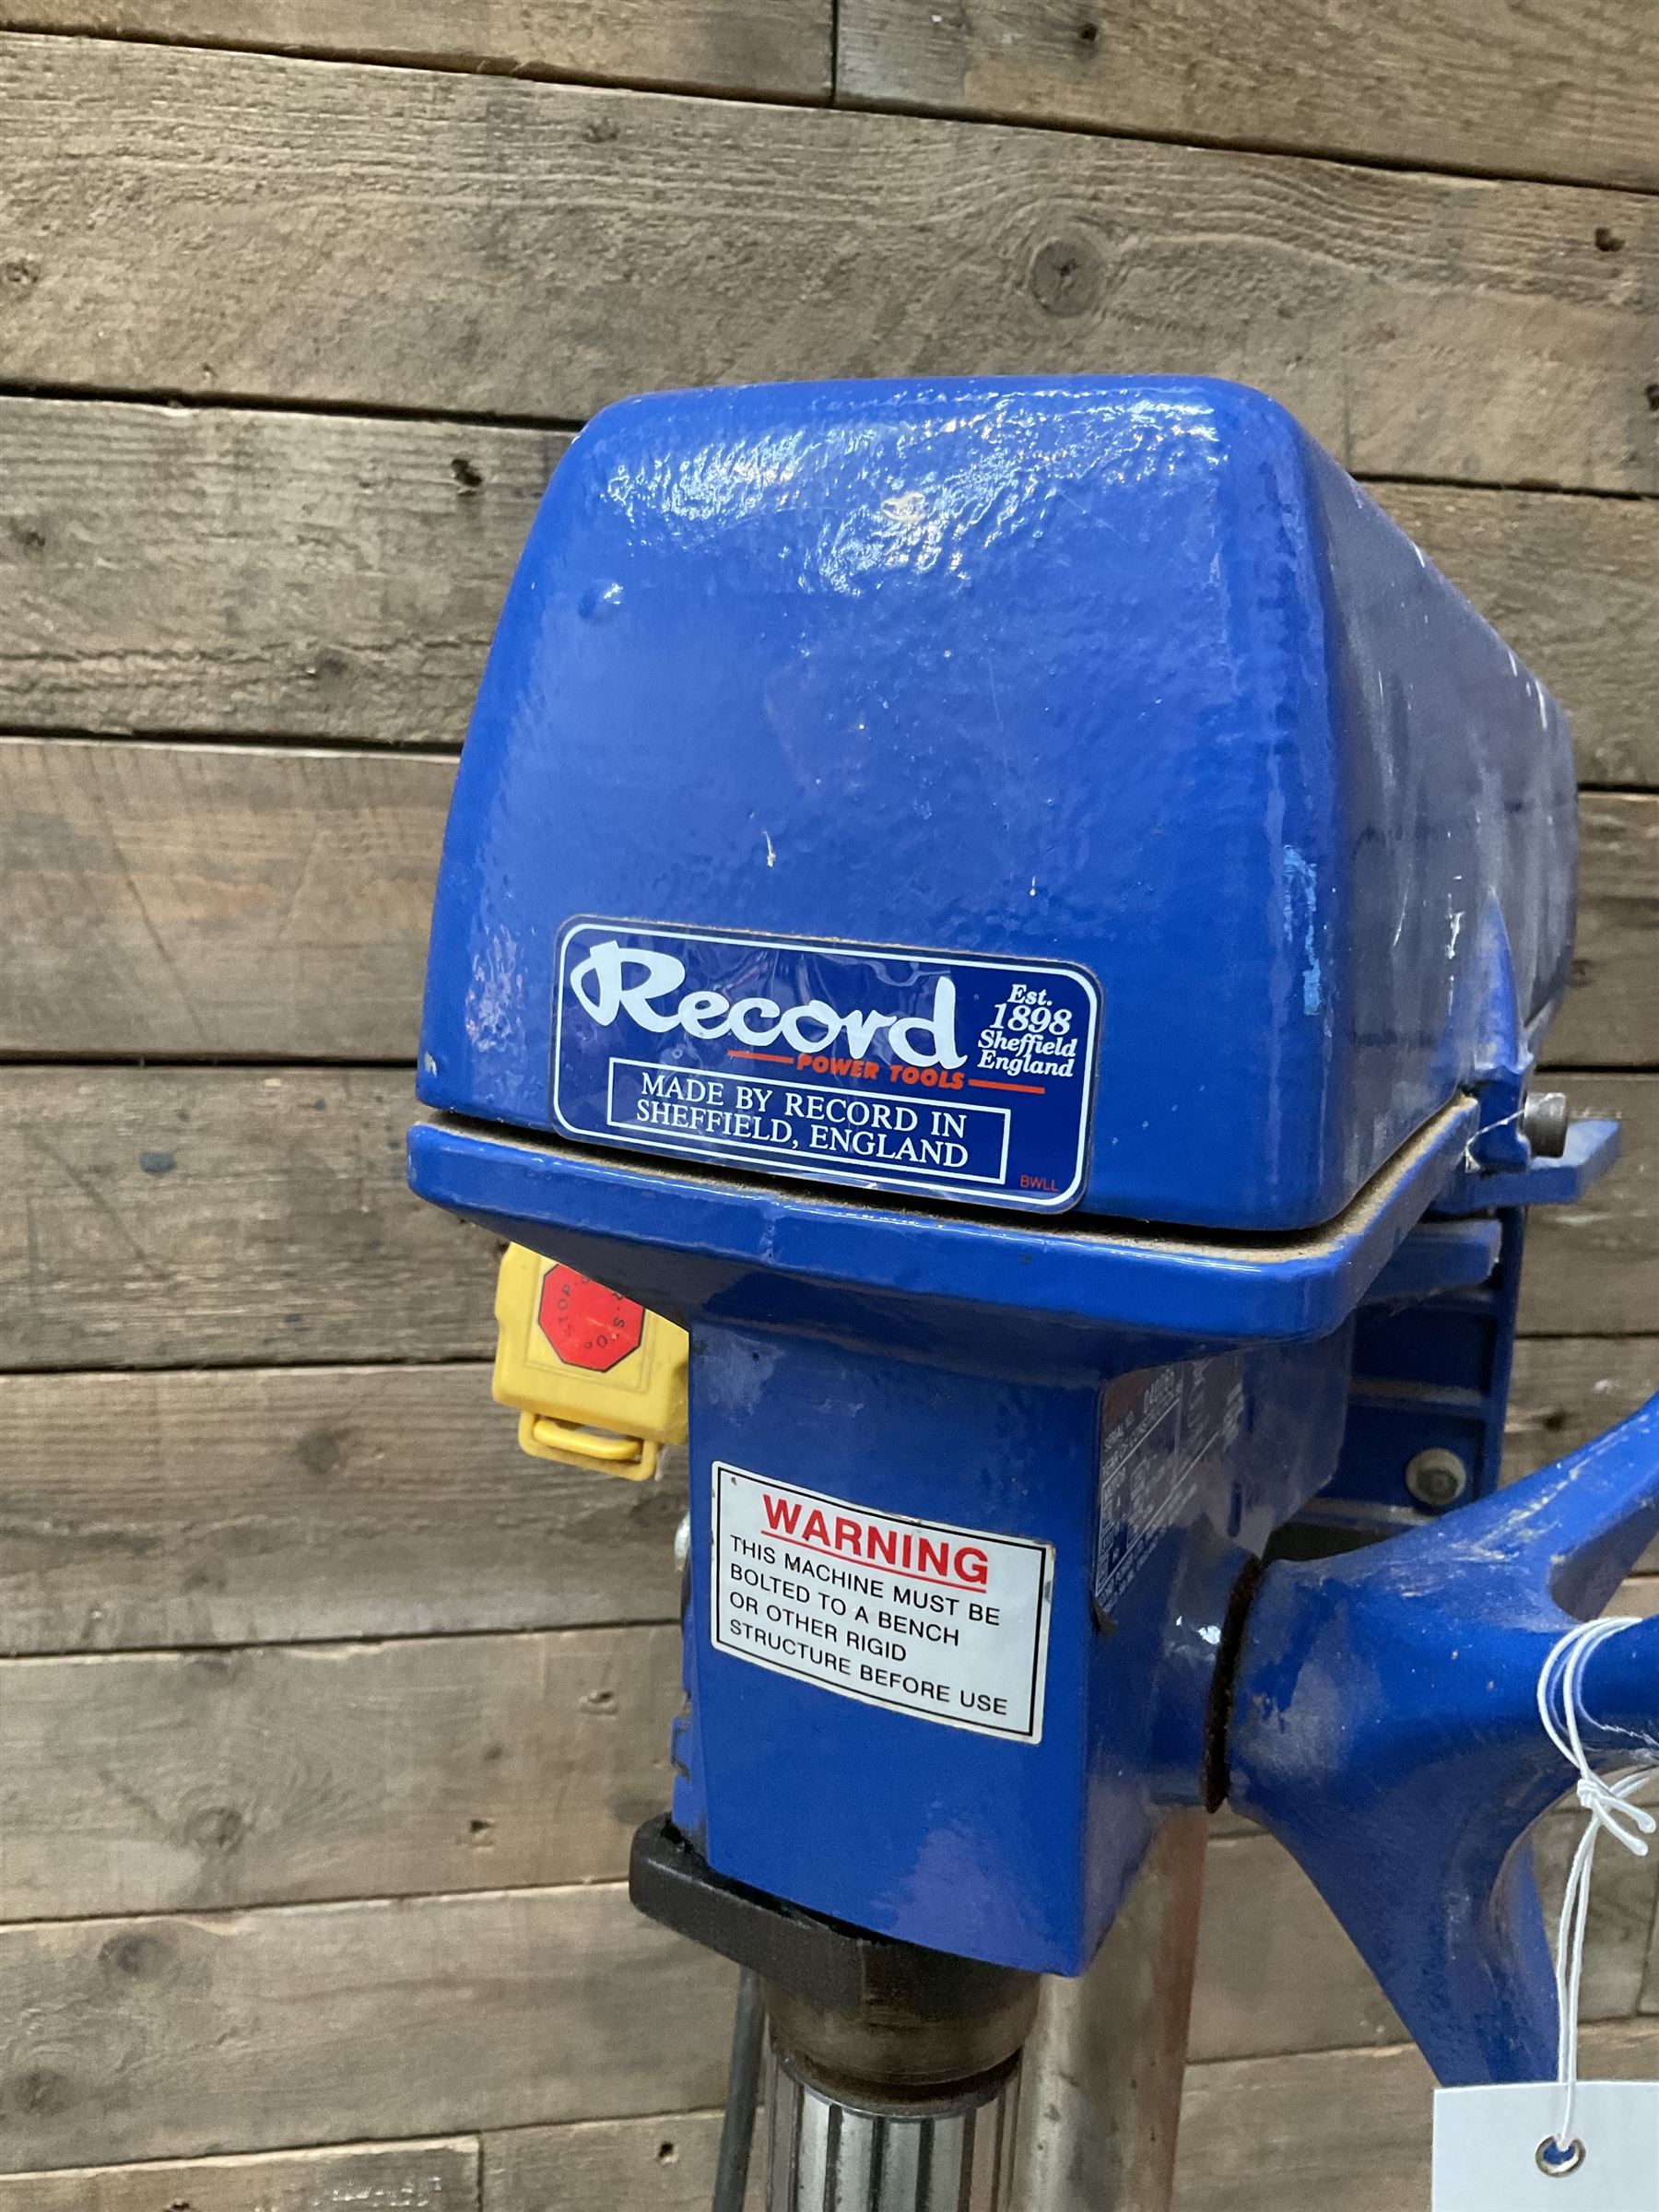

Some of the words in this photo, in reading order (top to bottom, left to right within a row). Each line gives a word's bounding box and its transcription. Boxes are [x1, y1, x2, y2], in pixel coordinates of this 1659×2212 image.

[571, 940, 968, 1069] Record
[992, 1002, 1073, 1036] 1898
[1008, 983, 1053, 1006] Est.
[796, 1053, 879, 1080] POWER
[890, 1063, 964, 1089] TOOLS
[977, 1051, 1074, 1077] England
[978, 1029, 1077, 1058] Sheffield
[636, 1100, 799, 1151] SHEFFIELD,
[809, 1131, 969, 1167] ENGLAND
[641, 1073, 724, 1105] MADE
[735, 1085, 772, 1111] BY
[785, 1093, 918, 1130] RECORD
[931, 1112, 967, 1138] IN
[1020, 1175, 1059, 1193] BWLL
[763, 1493, 988, 1585] WARNING
[731, 1535, 775, 1564] THIS
[784, 1553, 883, 1598] MACHINE
[893, 1585, 959, 1616] MUST
[969, 1604, 1000, 1626] BE
[731, 1564, 810, 1603] BOLTED
[818, 1593, 846, 1616] TO
[854, 1606, 868, 1623] A
[878, 1611, 959, 1646] BENCH
[730, 1592, 758, 1614] OR
[766, 1606, 837, 1642] OTHER
[847, 1630, 907, 1661] RIGID
[730, 1619, 851, 1675] STRUCTURE
[860, 1665, 950, 1701] BEFORE
[960, 1689, 1007, 1715] USE
